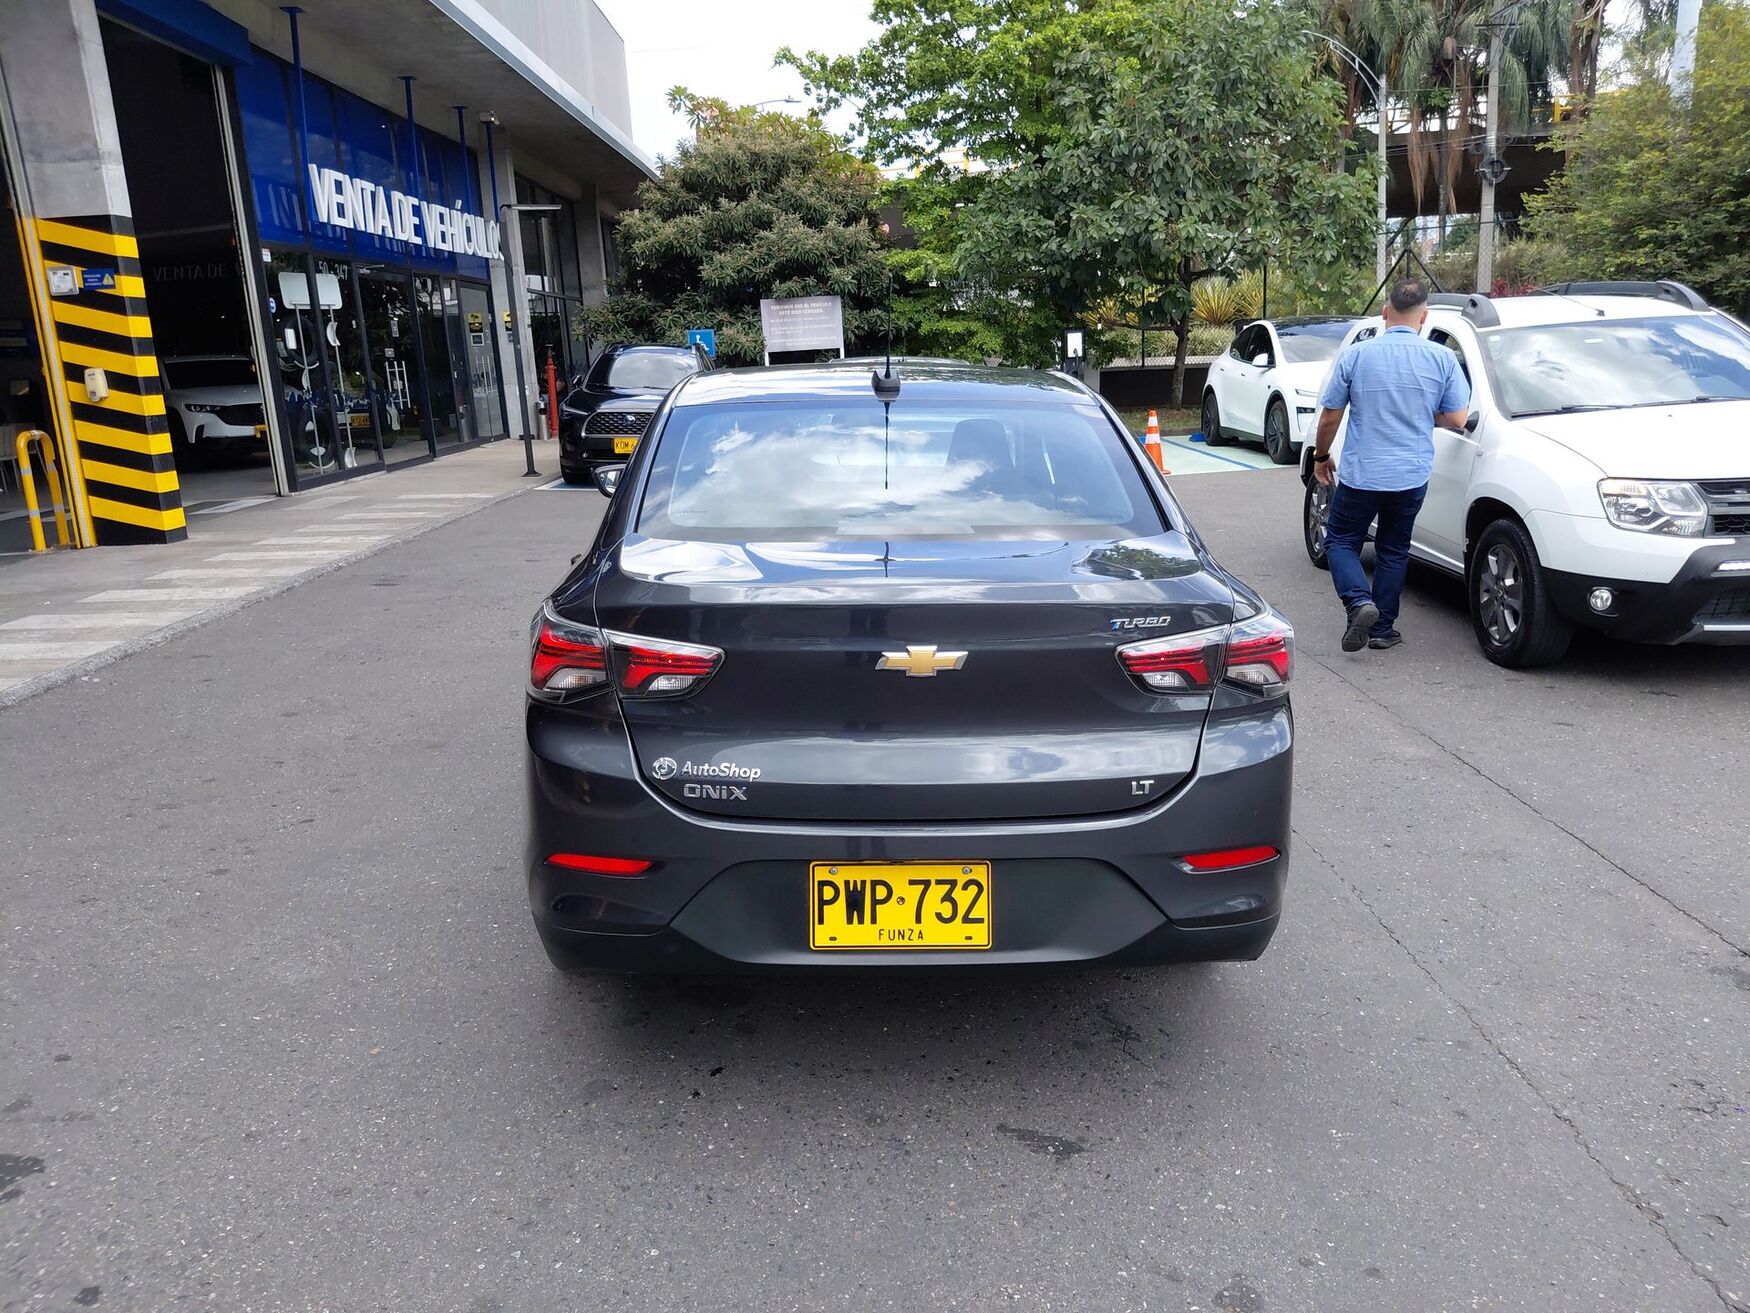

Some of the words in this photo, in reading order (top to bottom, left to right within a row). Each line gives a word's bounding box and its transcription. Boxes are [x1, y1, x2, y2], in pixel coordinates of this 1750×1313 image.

[308, 163, 394, 239] VENTA
[391, 190, 422, 245] DE
[152, 264, 205, 281] VENTA
[207, 263, 227, 279] DE
[1110, 615, 1171, 630] TURBO
[682, 761, 762, 782] AutoShop
[1131, 779, 1155, 796] LT
[878, 928, 924, 941] FUNZA
